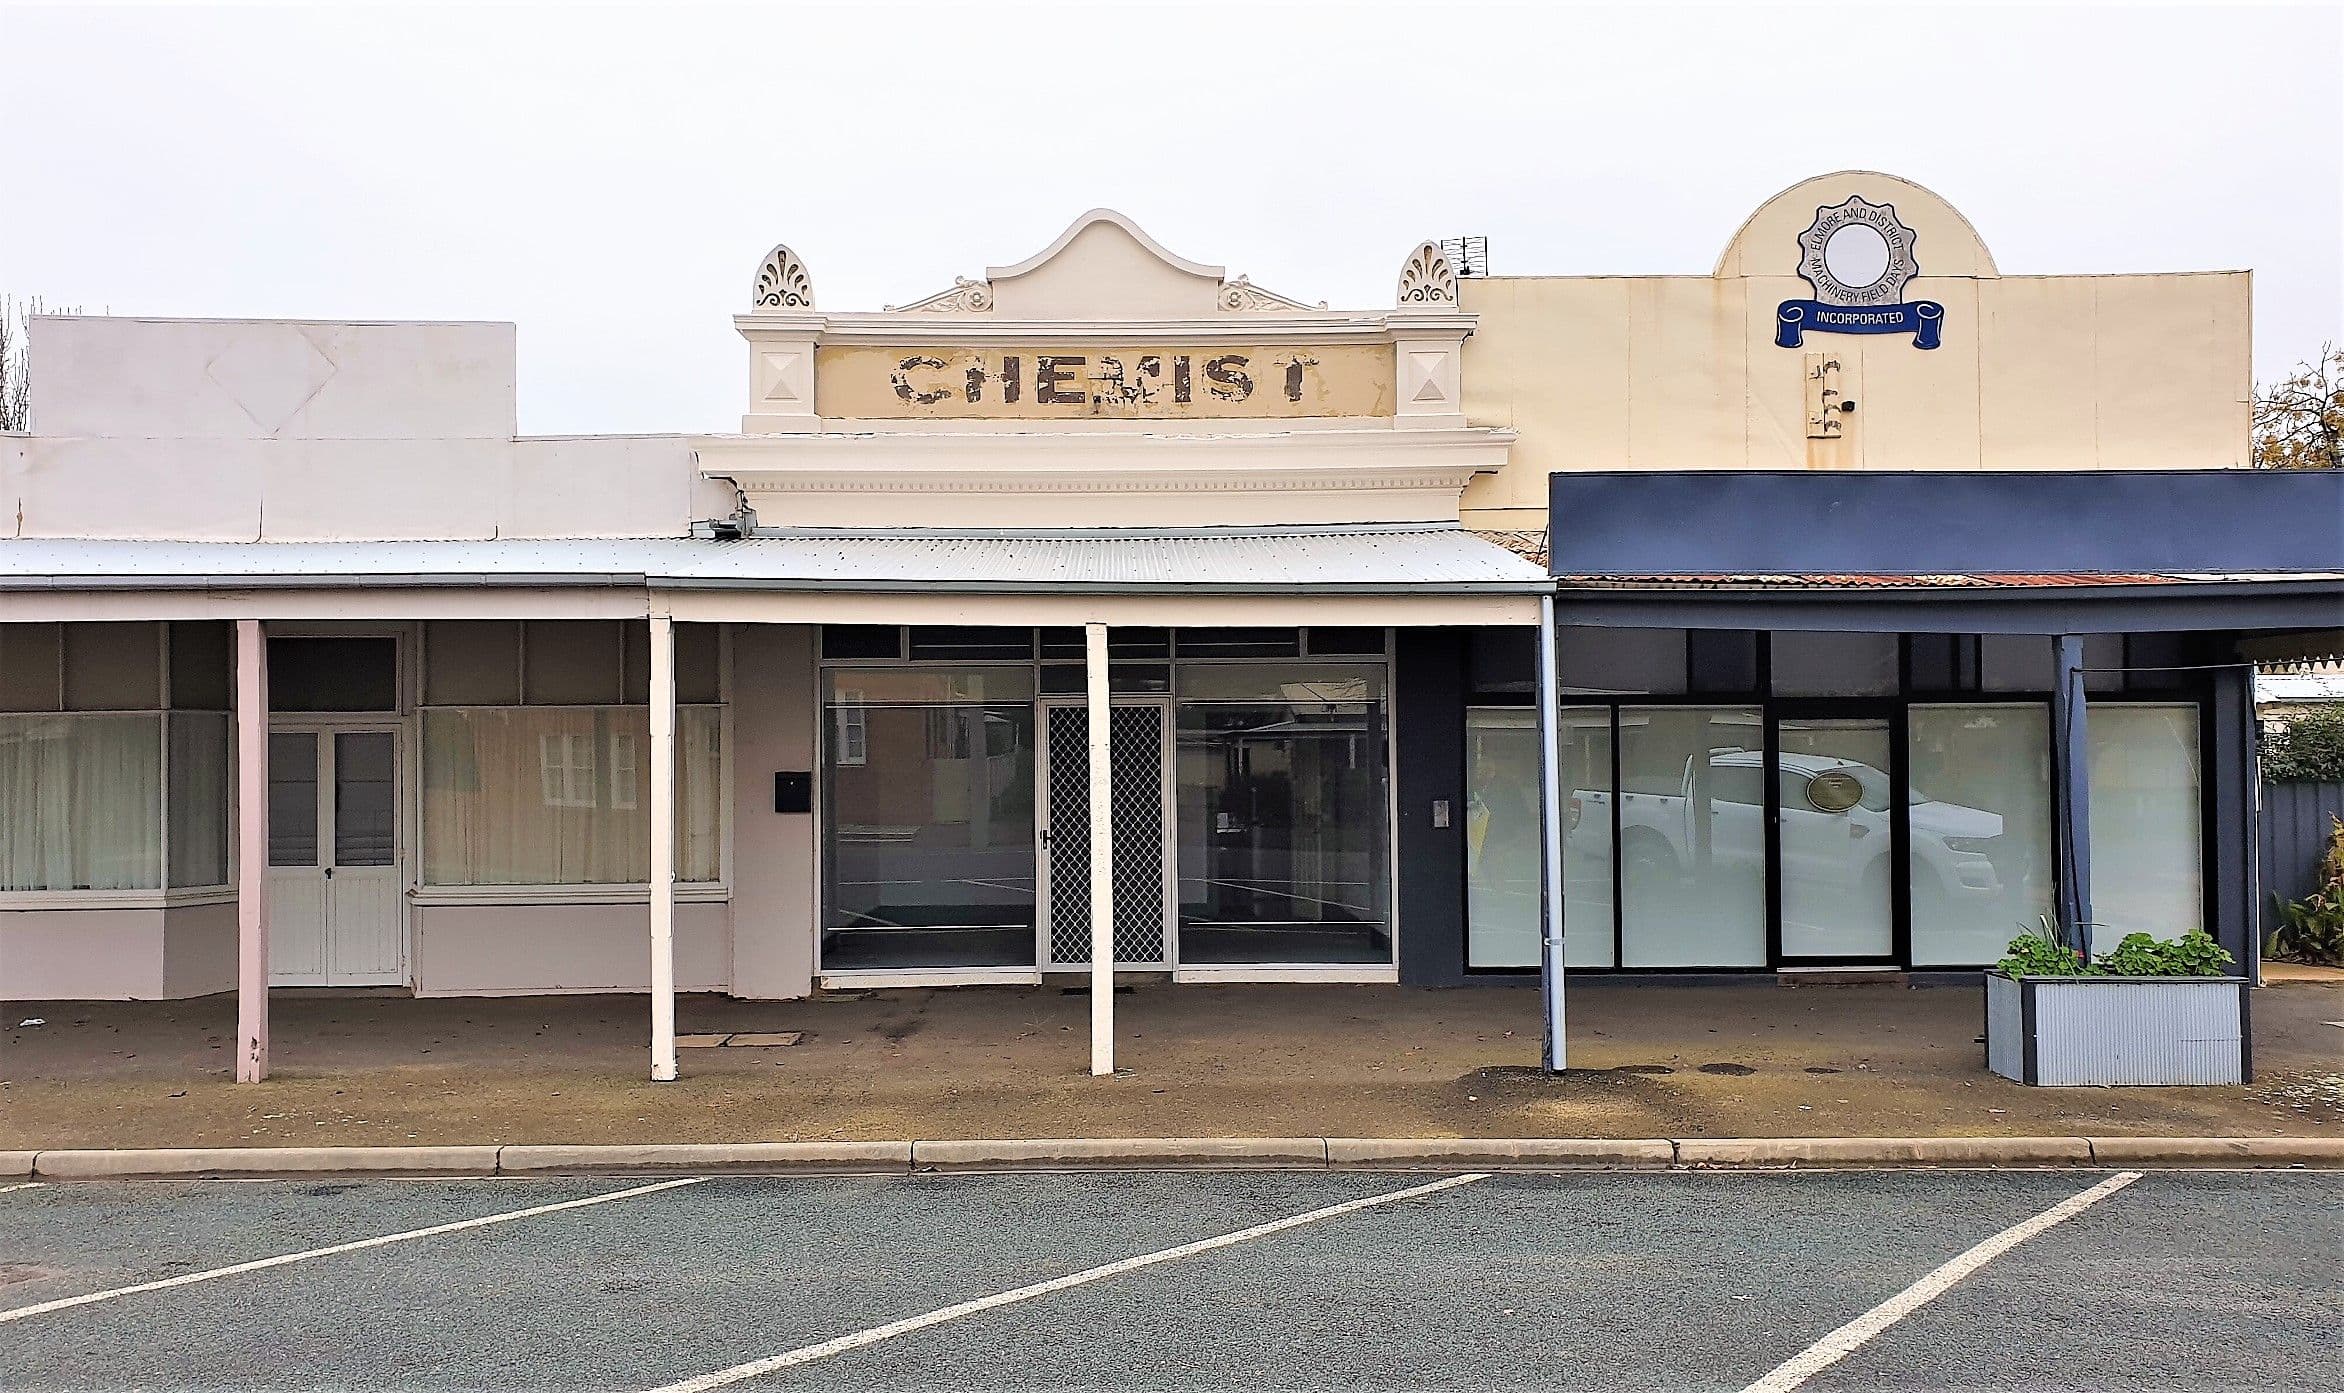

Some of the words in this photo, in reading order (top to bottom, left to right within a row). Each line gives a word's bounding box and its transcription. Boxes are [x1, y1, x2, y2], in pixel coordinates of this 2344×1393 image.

[1811, 212, 1841, 250] ELMORE
[1843, 208, 1867, 220] AND
[1869, 211, 1904, 251] DISTRICT
[1811, 259, 1859, 302] MACHINERY
[1861, 284, 1889, 302] FIELD
[1887, 259, 1904, 286] DAYS
[1817, 311, 1904, 324] INCORPORATED
[890, 355, 1320, 403] CHEMIST
